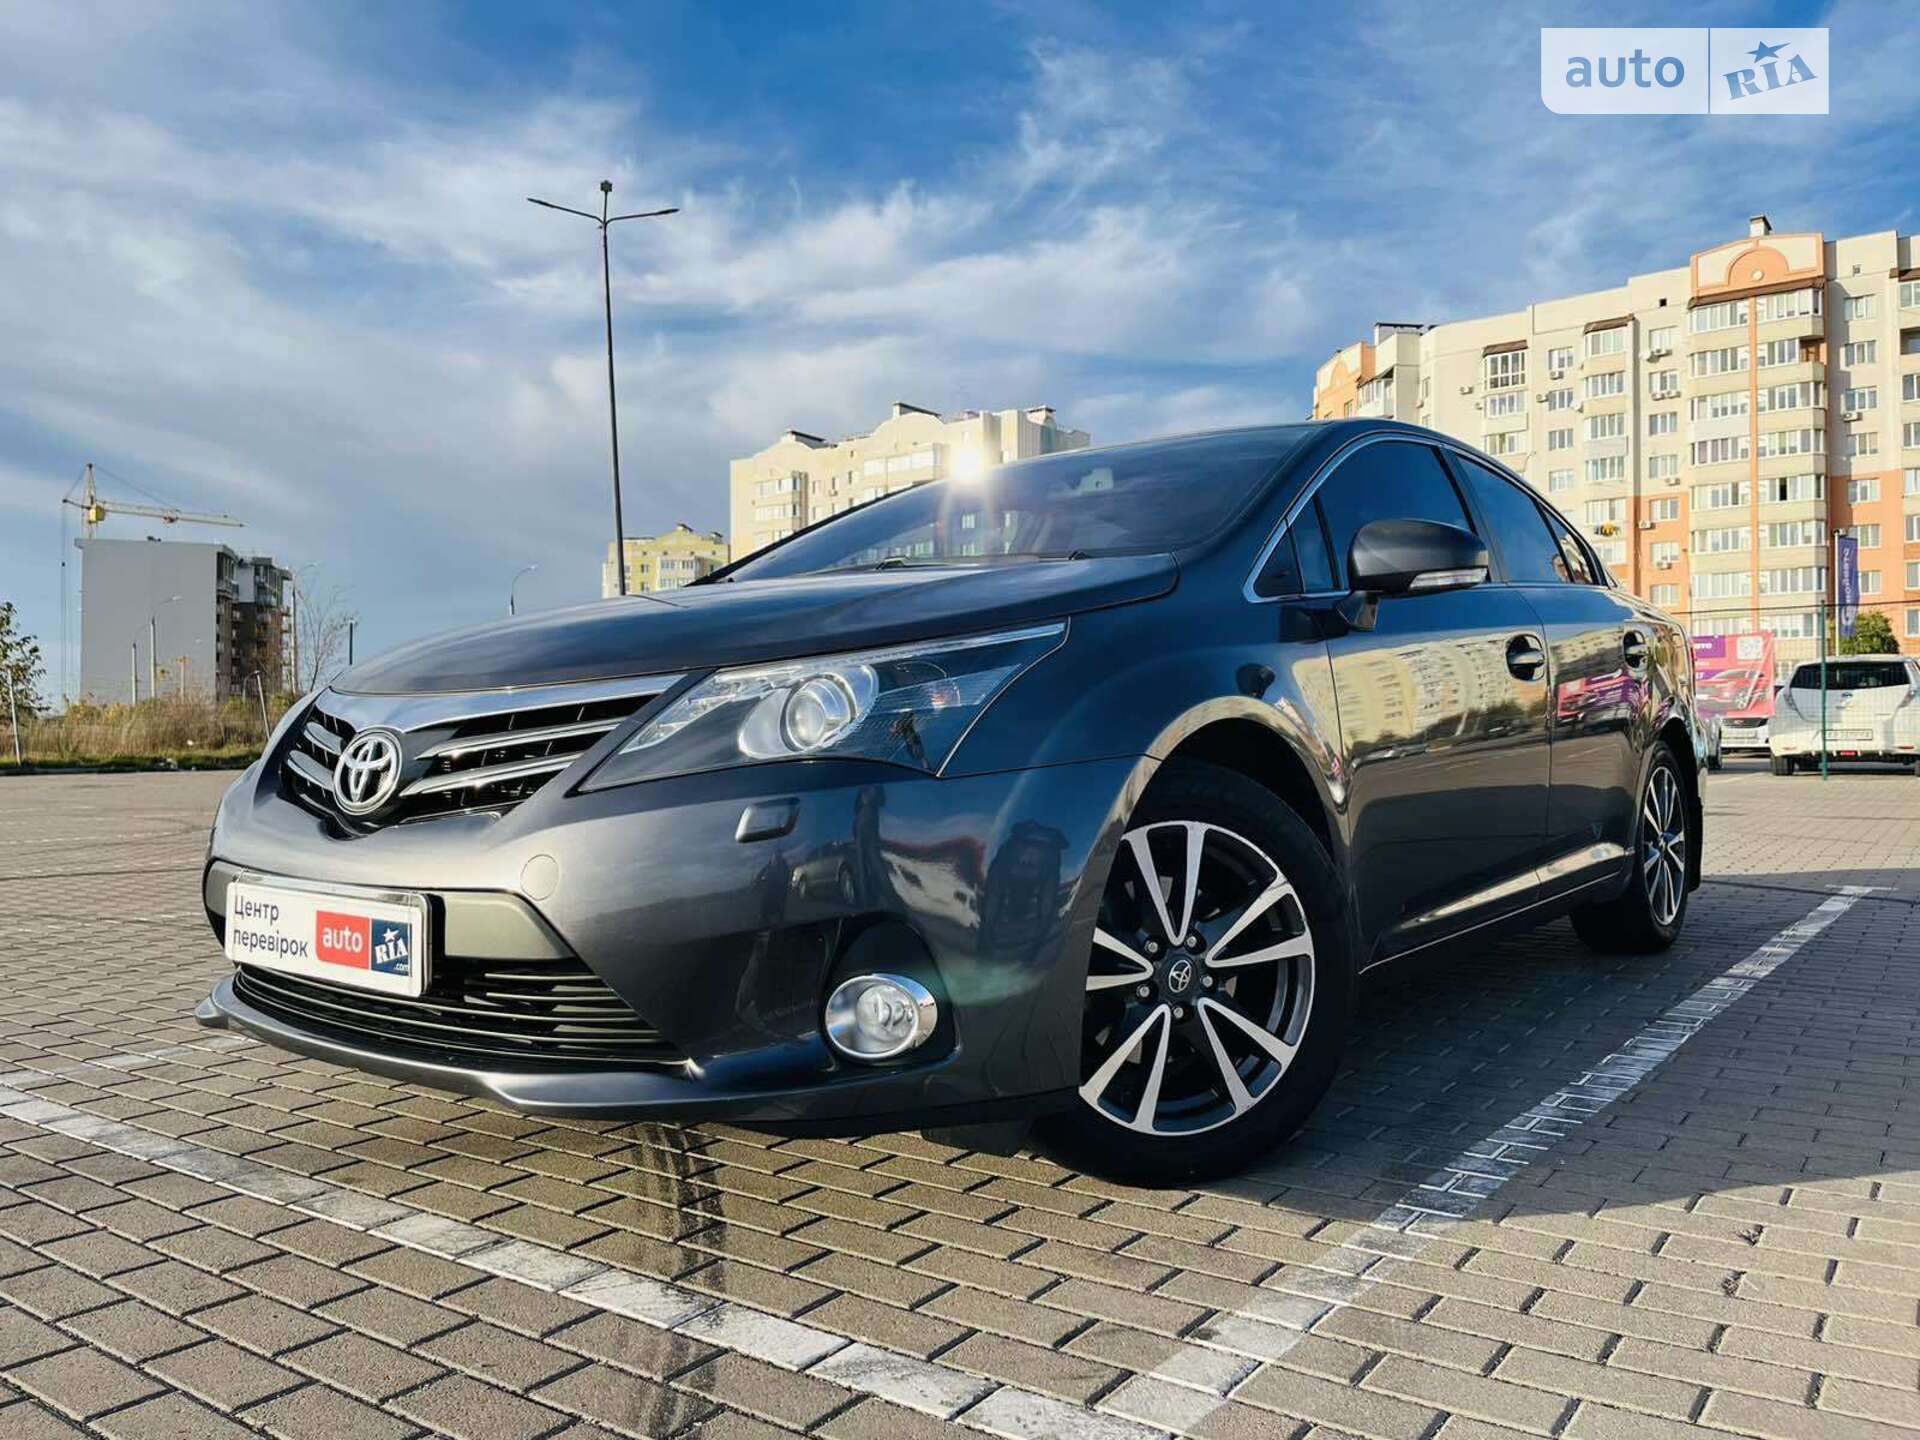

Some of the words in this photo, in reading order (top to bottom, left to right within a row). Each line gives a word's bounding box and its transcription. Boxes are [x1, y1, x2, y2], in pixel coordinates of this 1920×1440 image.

[234, 895, 279, 925] Центр
[233, 928, 308, 958] перевірок
[322, 926, 363, 953] auto
[374, 937, 408, 964] RIA
